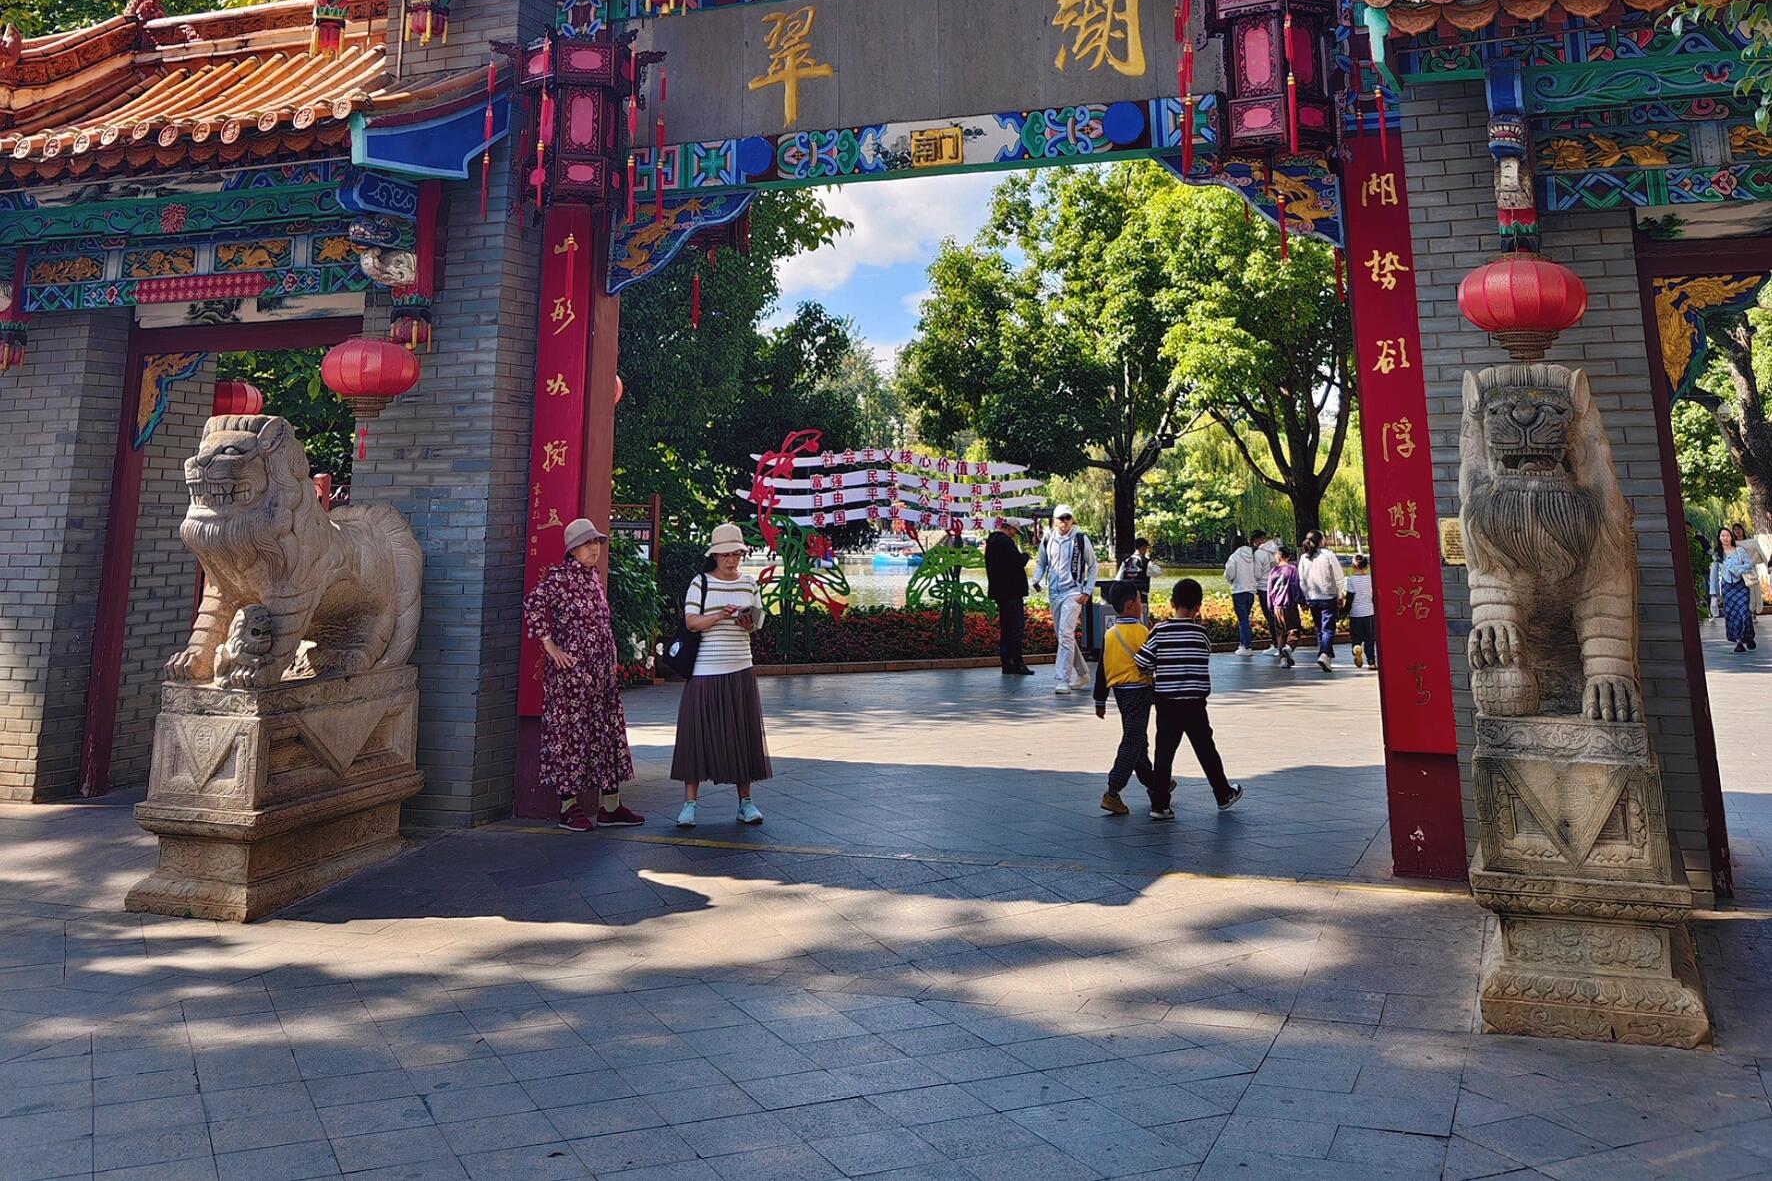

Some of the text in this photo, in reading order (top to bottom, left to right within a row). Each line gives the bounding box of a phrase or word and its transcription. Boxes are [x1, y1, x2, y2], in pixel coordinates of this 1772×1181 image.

[914, 130, 960, 163] 南门
[821, 447, 989, 477] 社会主义核心价值观
[810, 469, 1001, 496] 富强 民主 文明 和谐
[813, 487, 1002, 513] 自由 平等 公正 法治
[812, 510, 846, 527] 爱国
[867, 505, 900, 520] 敬业
[919, 511, 949, 529] 诚信
